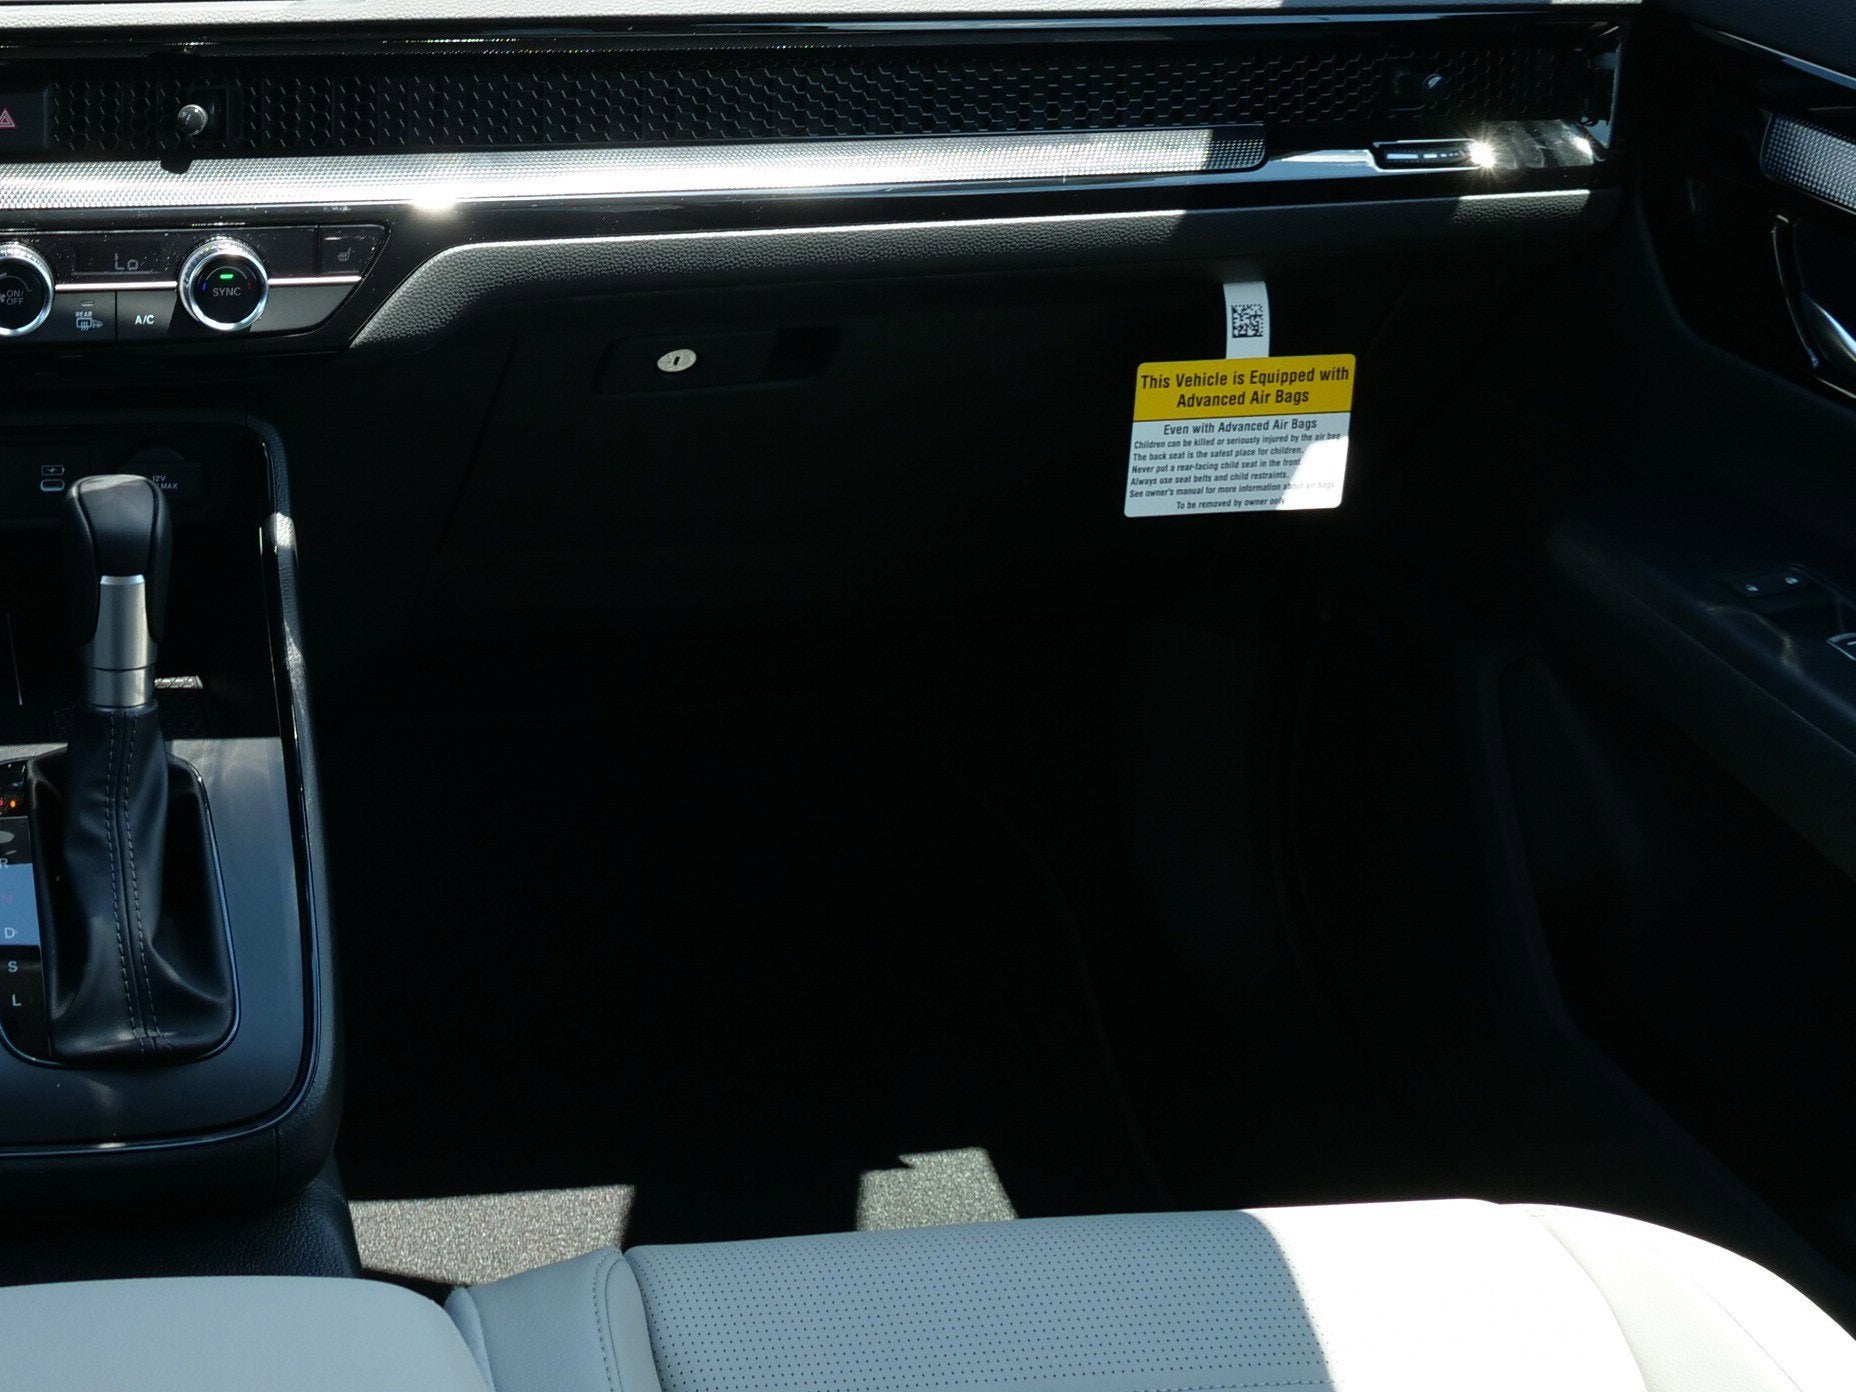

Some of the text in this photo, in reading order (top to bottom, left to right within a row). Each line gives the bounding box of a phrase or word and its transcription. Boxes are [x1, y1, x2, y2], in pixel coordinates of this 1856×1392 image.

[6, 290, 25, 299] ON/
[212, 287, 241, 297] SYNC
[6, 297, 24, 306] OFF
[135, 314, 155, 325] A/C
[1141, 366, 1349, 389] This Vehicle is Equipped with
[1177, 389, 1309, 408] Advanced Air Bags
[1163, 418, 1317, 435] Even with Advanced Air Bags
[1134, 439, 1165, 449] Children
[1167, 439, 1181, 447] can
[1183, 438, 1192, 446] be
[1194, 437, 1215, 446] killed
[1226, 436, 1260, 445] seriously
[1262, 434, 1288, 444] injured
[1290, 434, 1299, 443] by
[1301, 433, 1313, 441] the
[1315, 432, 1326, 440] air
[1133, 446, 1304, 461] The back seat is the safest place for children.
[1131, 465, 1157, 474] Never
[1156, 465, 1168, 474] put
[1177, 462, 1218, 471] rear-facing
[1221, 461, 1239, 470] child
[1241, 460, 1258, 469] seat
[1260, 459, 1266, 467] in
[1269, 459, 1281, 467] the
[1130, 477, 1157, 486] Always
[1159, 477, 1173, 485] use
[1175, 476, 1191, 484] seat
[1193, 474, 1212, 483] belts
[1230, 472, 1248, 481] child
[1251, 470, 1289, 480] restraints.
[1129, 489, 1143, 498] See
[1145, 488, 1174, 497] owner's
[1176, 487, 1203, 496] manual
[1205, 486, 1216, 495] for
[1238, 483, 1281, 492] information
[1176, 497, 1267, 509] To be removed by owner
[5, 927, 15, 939] D
[8, 961, 18, 972] S
[12, 994, 22, 1006] L
